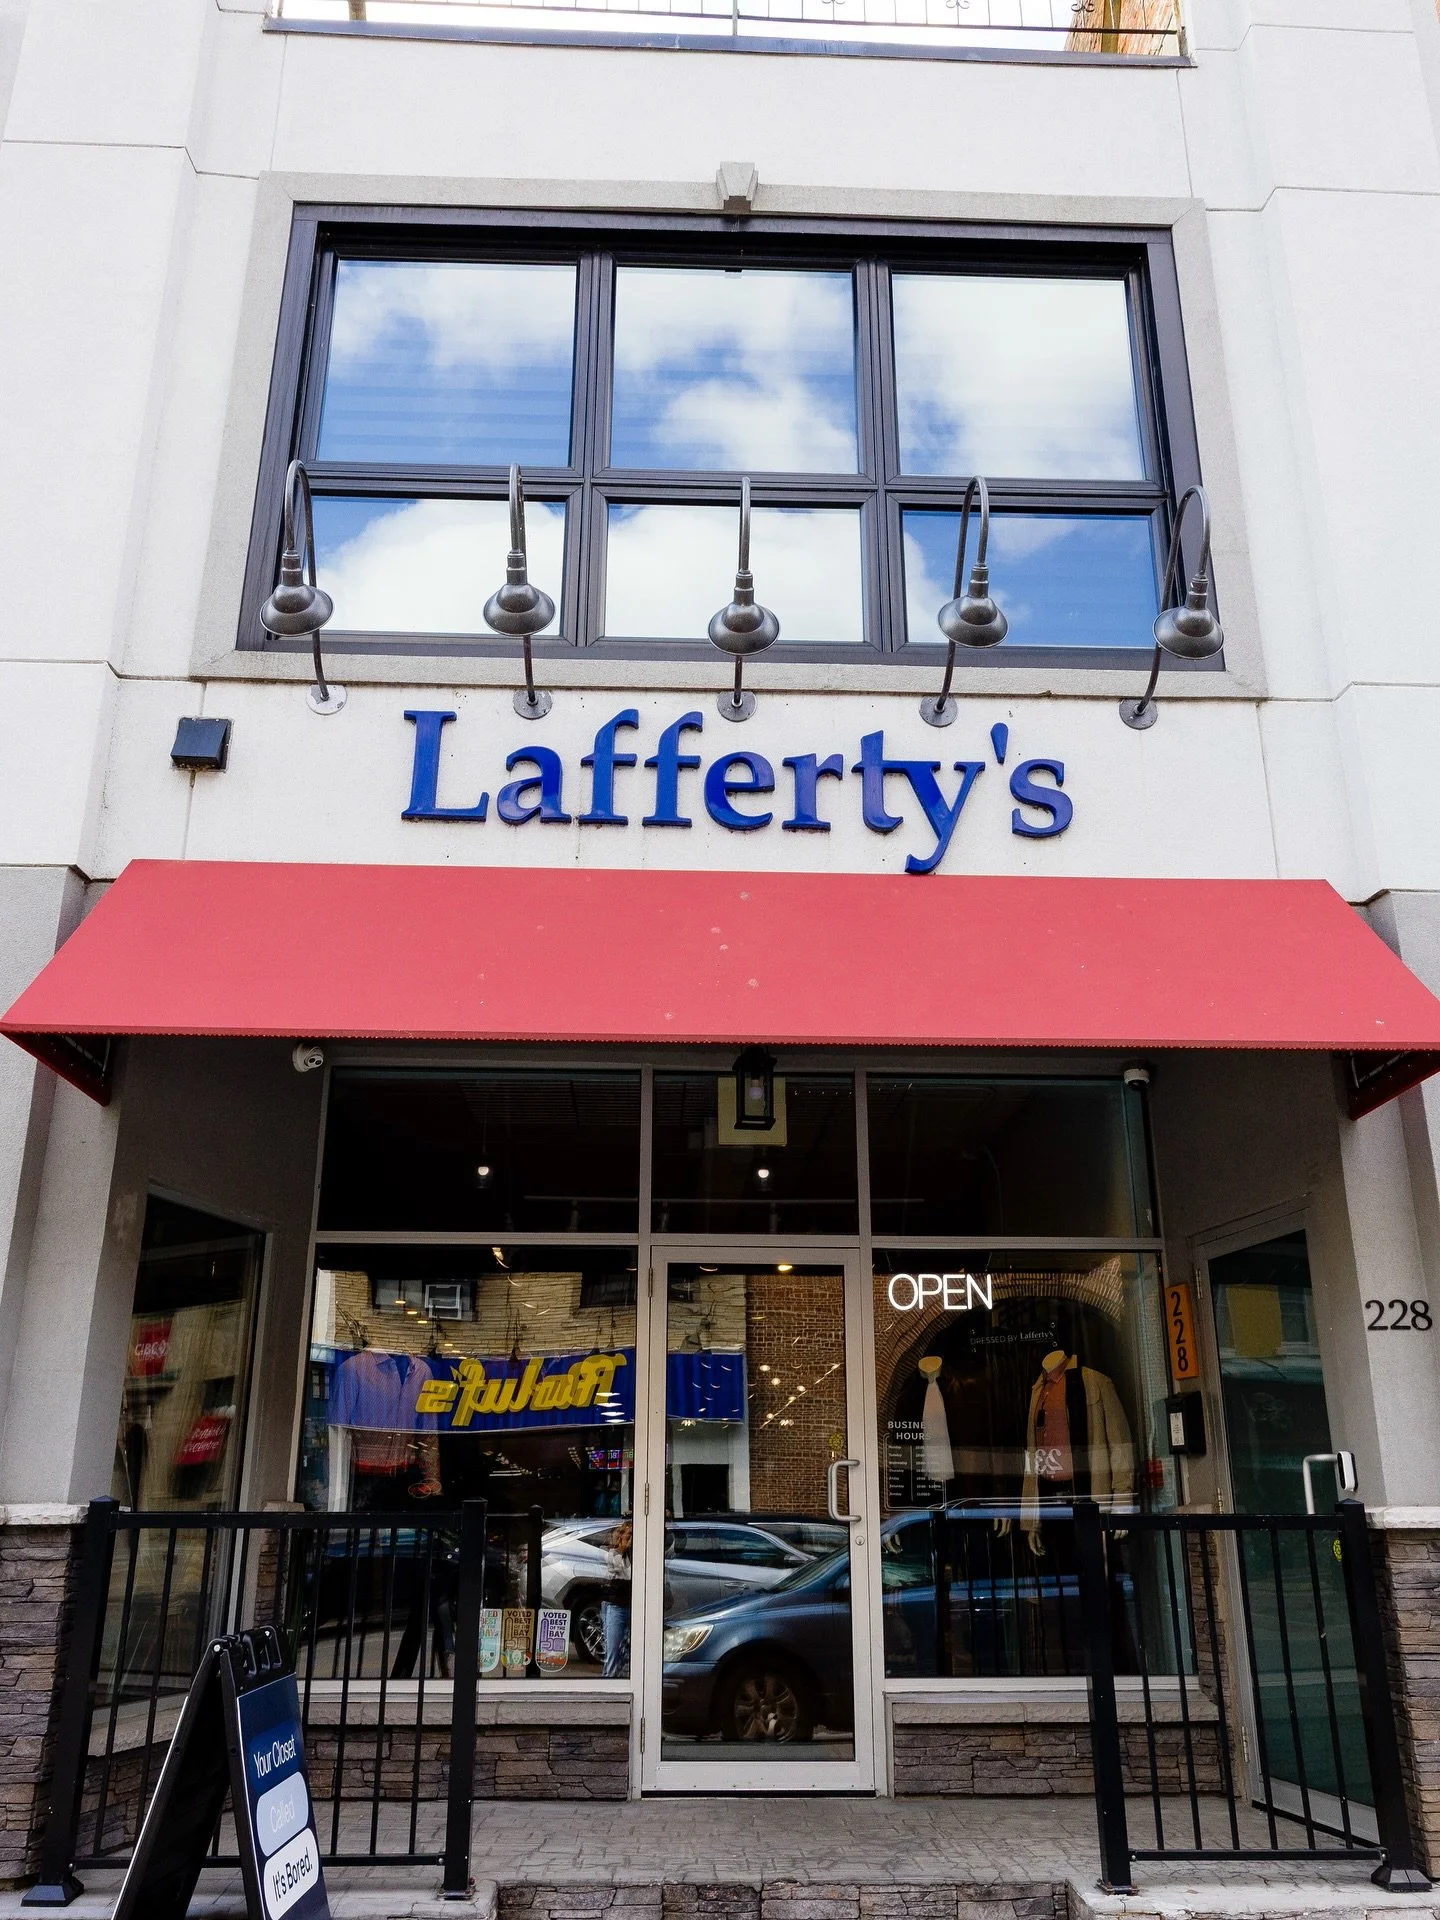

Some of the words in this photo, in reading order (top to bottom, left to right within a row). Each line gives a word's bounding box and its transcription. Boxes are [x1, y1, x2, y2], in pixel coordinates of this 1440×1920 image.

[401, 708, 1074, 875] Lafferty's
[888, 1273, 993, 1311] OPEN
[1170, 1291, 1189, 1372] 228
[1365, 1299, 1433, 1331] 228
[970, 1335, 1006, 1345] DRESSED
[1008, 1334, 1018, 1342] BY
[1020, 1331, 1054, 1340] Lafferty's
[887, 1421, 926, 1429] BUSINE
[507, 1610, 532, 1618] VOTED
[543, 1611, 568, 1619] VOTED
[549, 1630, 565, 1638] BAY
[253, 1750, 273, 1779] Your
[272, 1734, 297, 1768] Closet
[269, 1795, 296, 1834] Called
[272, 1869, 287, 1902] It's
[286, 1847, 313, 1890] Bored.
